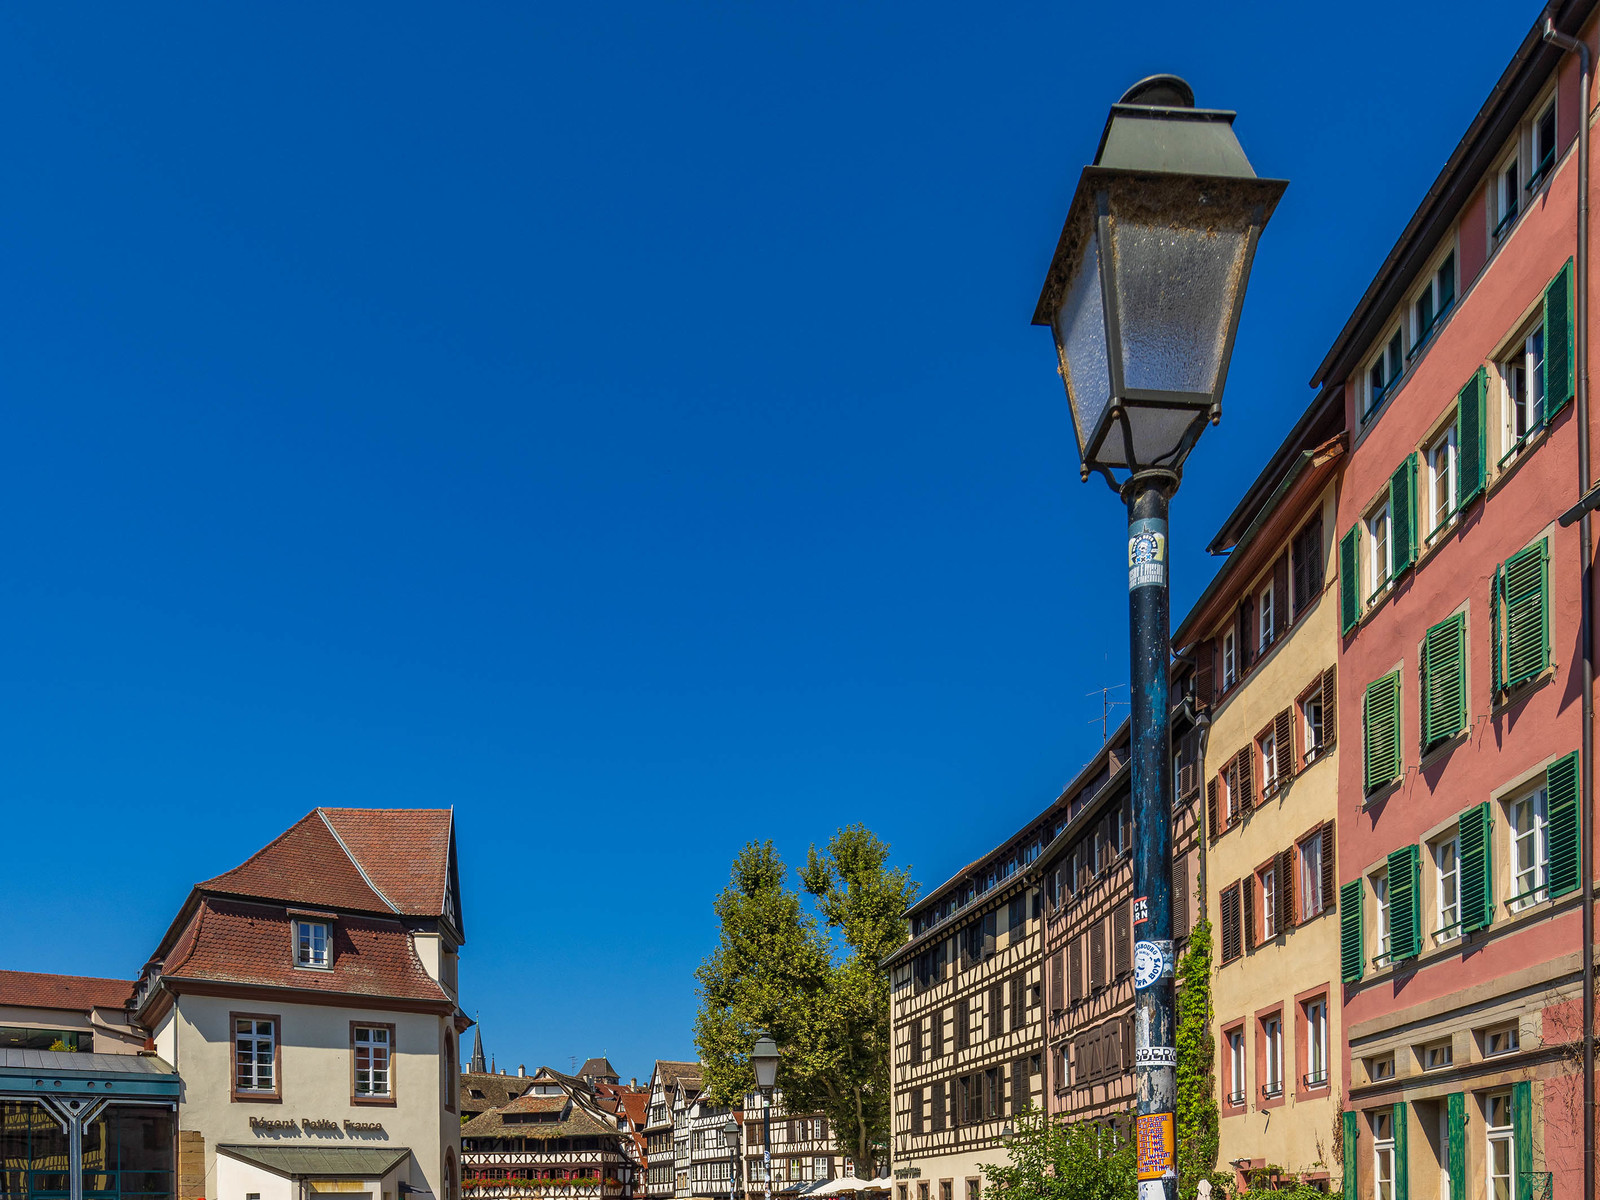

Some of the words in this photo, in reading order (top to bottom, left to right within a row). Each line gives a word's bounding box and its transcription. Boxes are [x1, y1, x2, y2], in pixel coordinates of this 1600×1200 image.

[1148, 957, 1161, 980] BOYS
[249, 1116, 295, 1131] Régent
[301, 1118, 338, 1130] Petite
[343, 1119, 383, 1131] France
